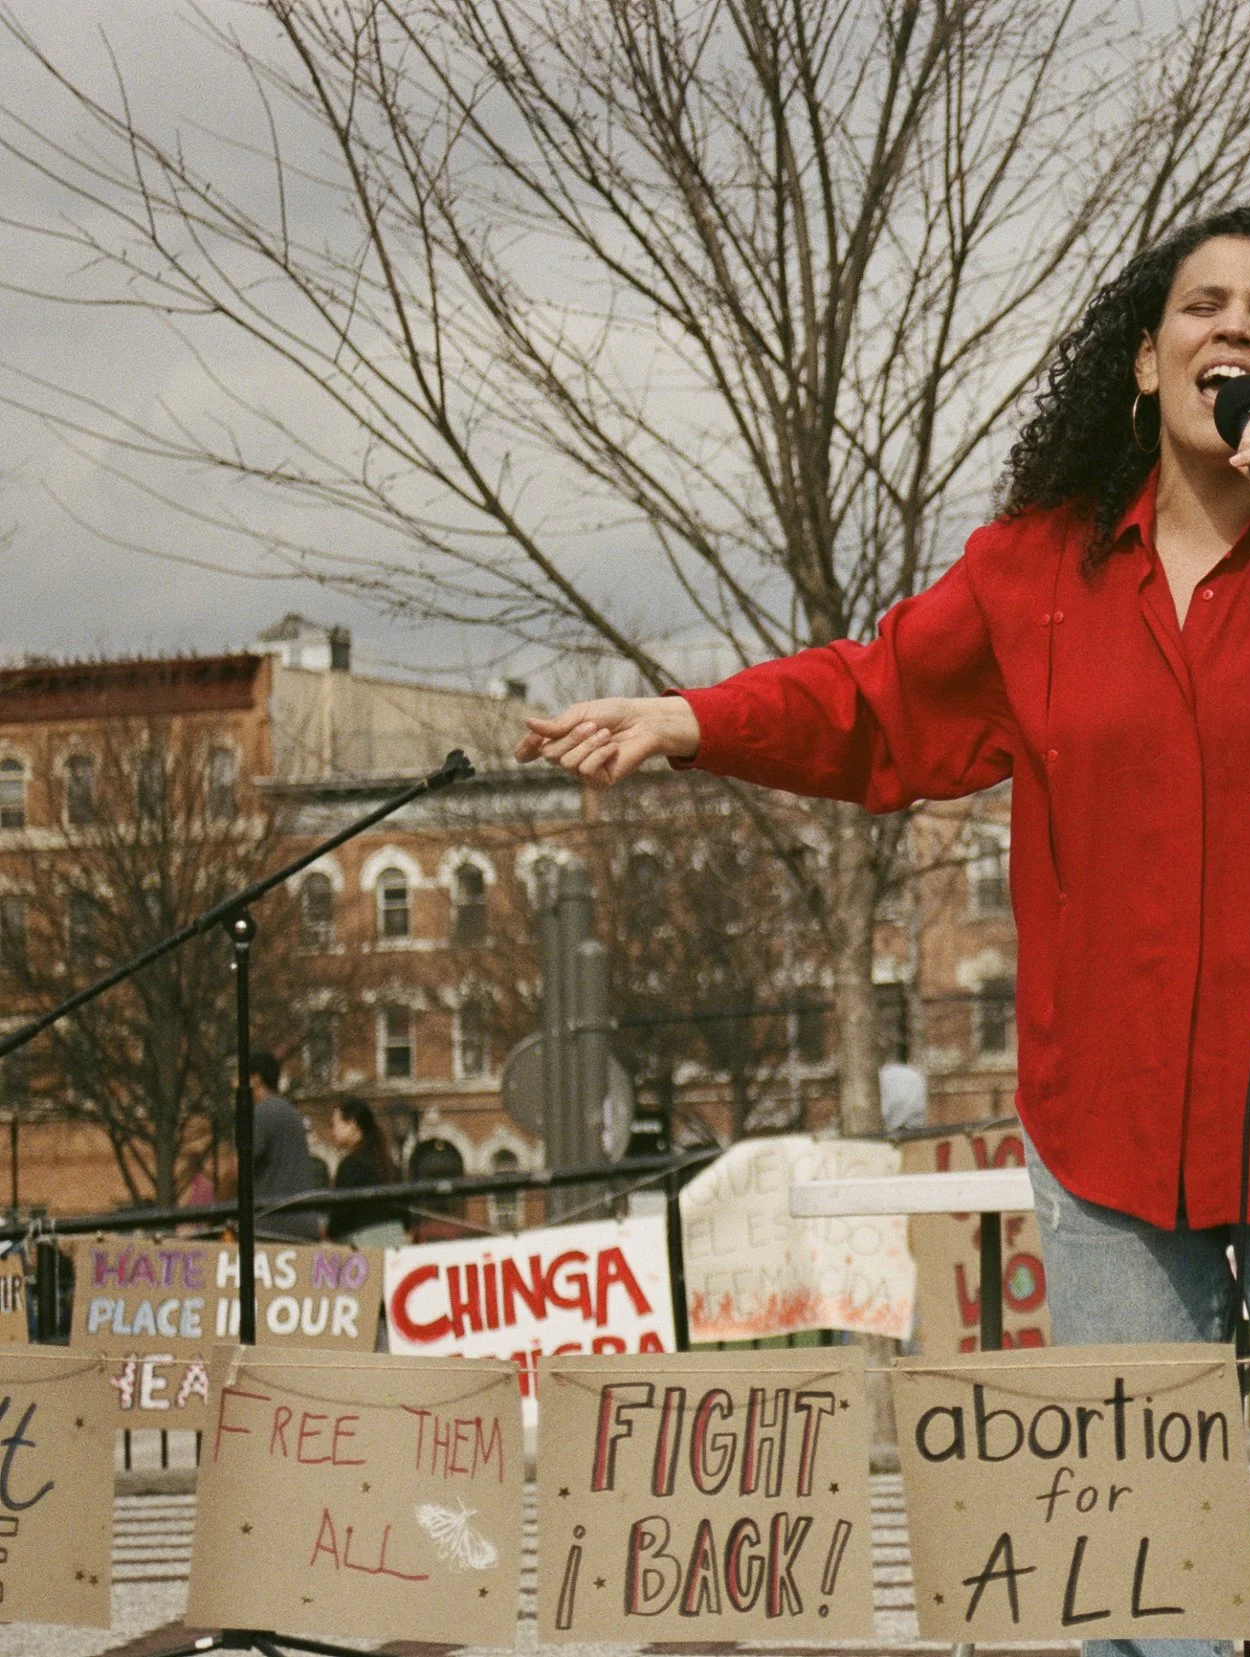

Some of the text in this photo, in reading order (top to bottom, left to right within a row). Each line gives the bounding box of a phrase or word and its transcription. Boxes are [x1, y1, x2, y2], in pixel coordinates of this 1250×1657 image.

[91, 1244, 369, 1291] HATE HAS NO
[87, 1296, 205, 1339] PLACE
[266, 1295, 360, 1339] OUR
[214, 1387, 503, 1483] FREE THEM
[591, 1381, 835, 1497] FIGHT
[915, 1377, 1229, 1463] abortion
[1035, 1466, 1133, 1523] for
[310, 1507, 430, 1581] ALL
[962, 1531, 1186, 1626] ALL
